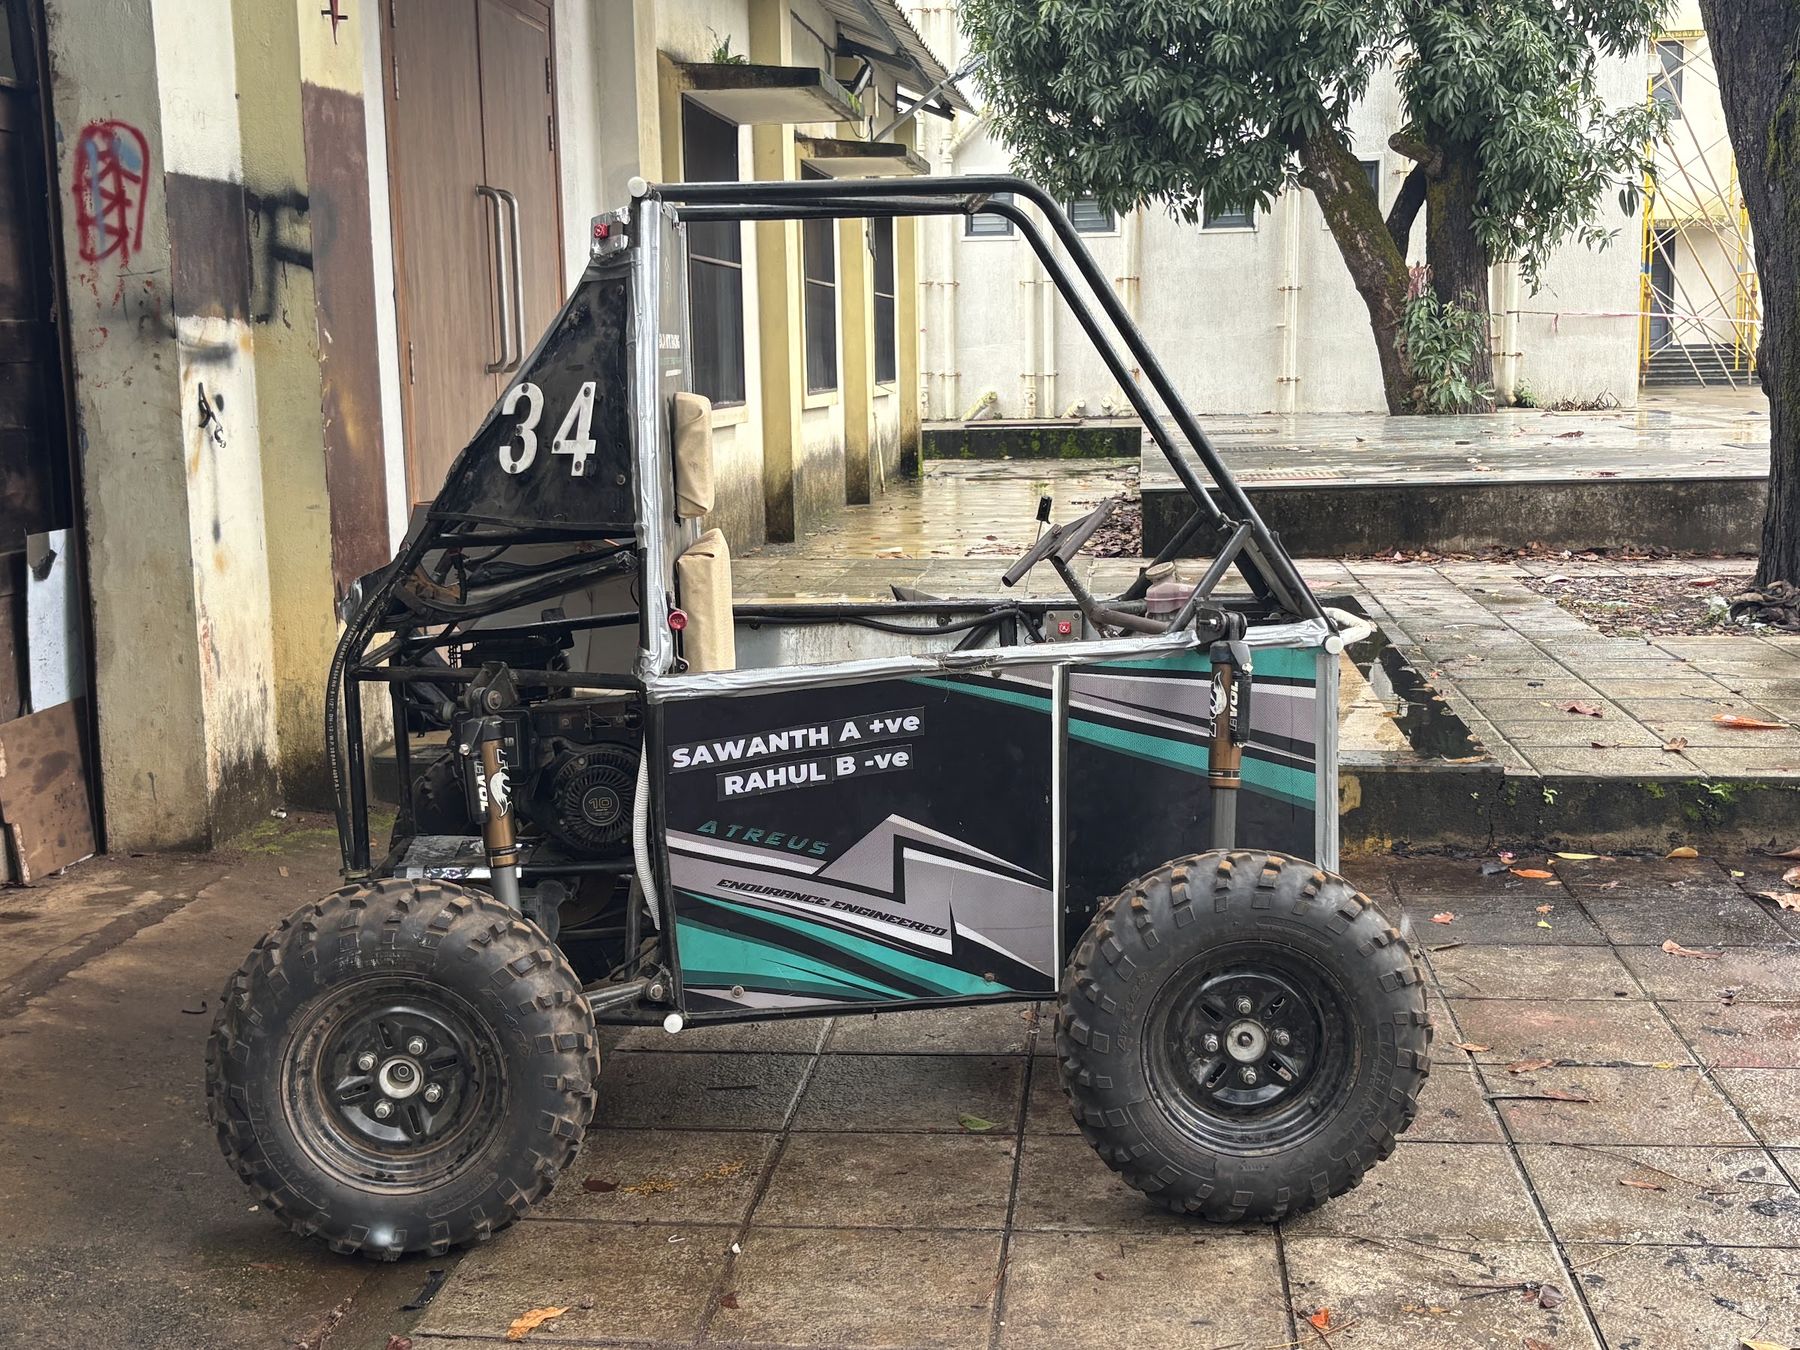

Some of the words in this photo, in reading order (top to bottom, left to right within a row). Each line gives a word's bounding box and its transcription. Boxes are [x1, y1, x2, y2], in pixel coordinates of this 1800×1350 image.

[499, 381, 597, 476] 34
[672, 726, 829, 768] SAWANTH
[839, 721, 861, 742] A
[869, 715, 920, 734] +ve
[725, 762, 826, 796] RAHUL
[836, 756, 857, 776] B
[865, 751, 910, 770] -ve
[589, 797, 613, 809] 10
[697, 820, 830, 855] ATREUS
[716, 879, 830, 906] ENDURANCE
[830, 900, 948, 937] ENGINEERED
